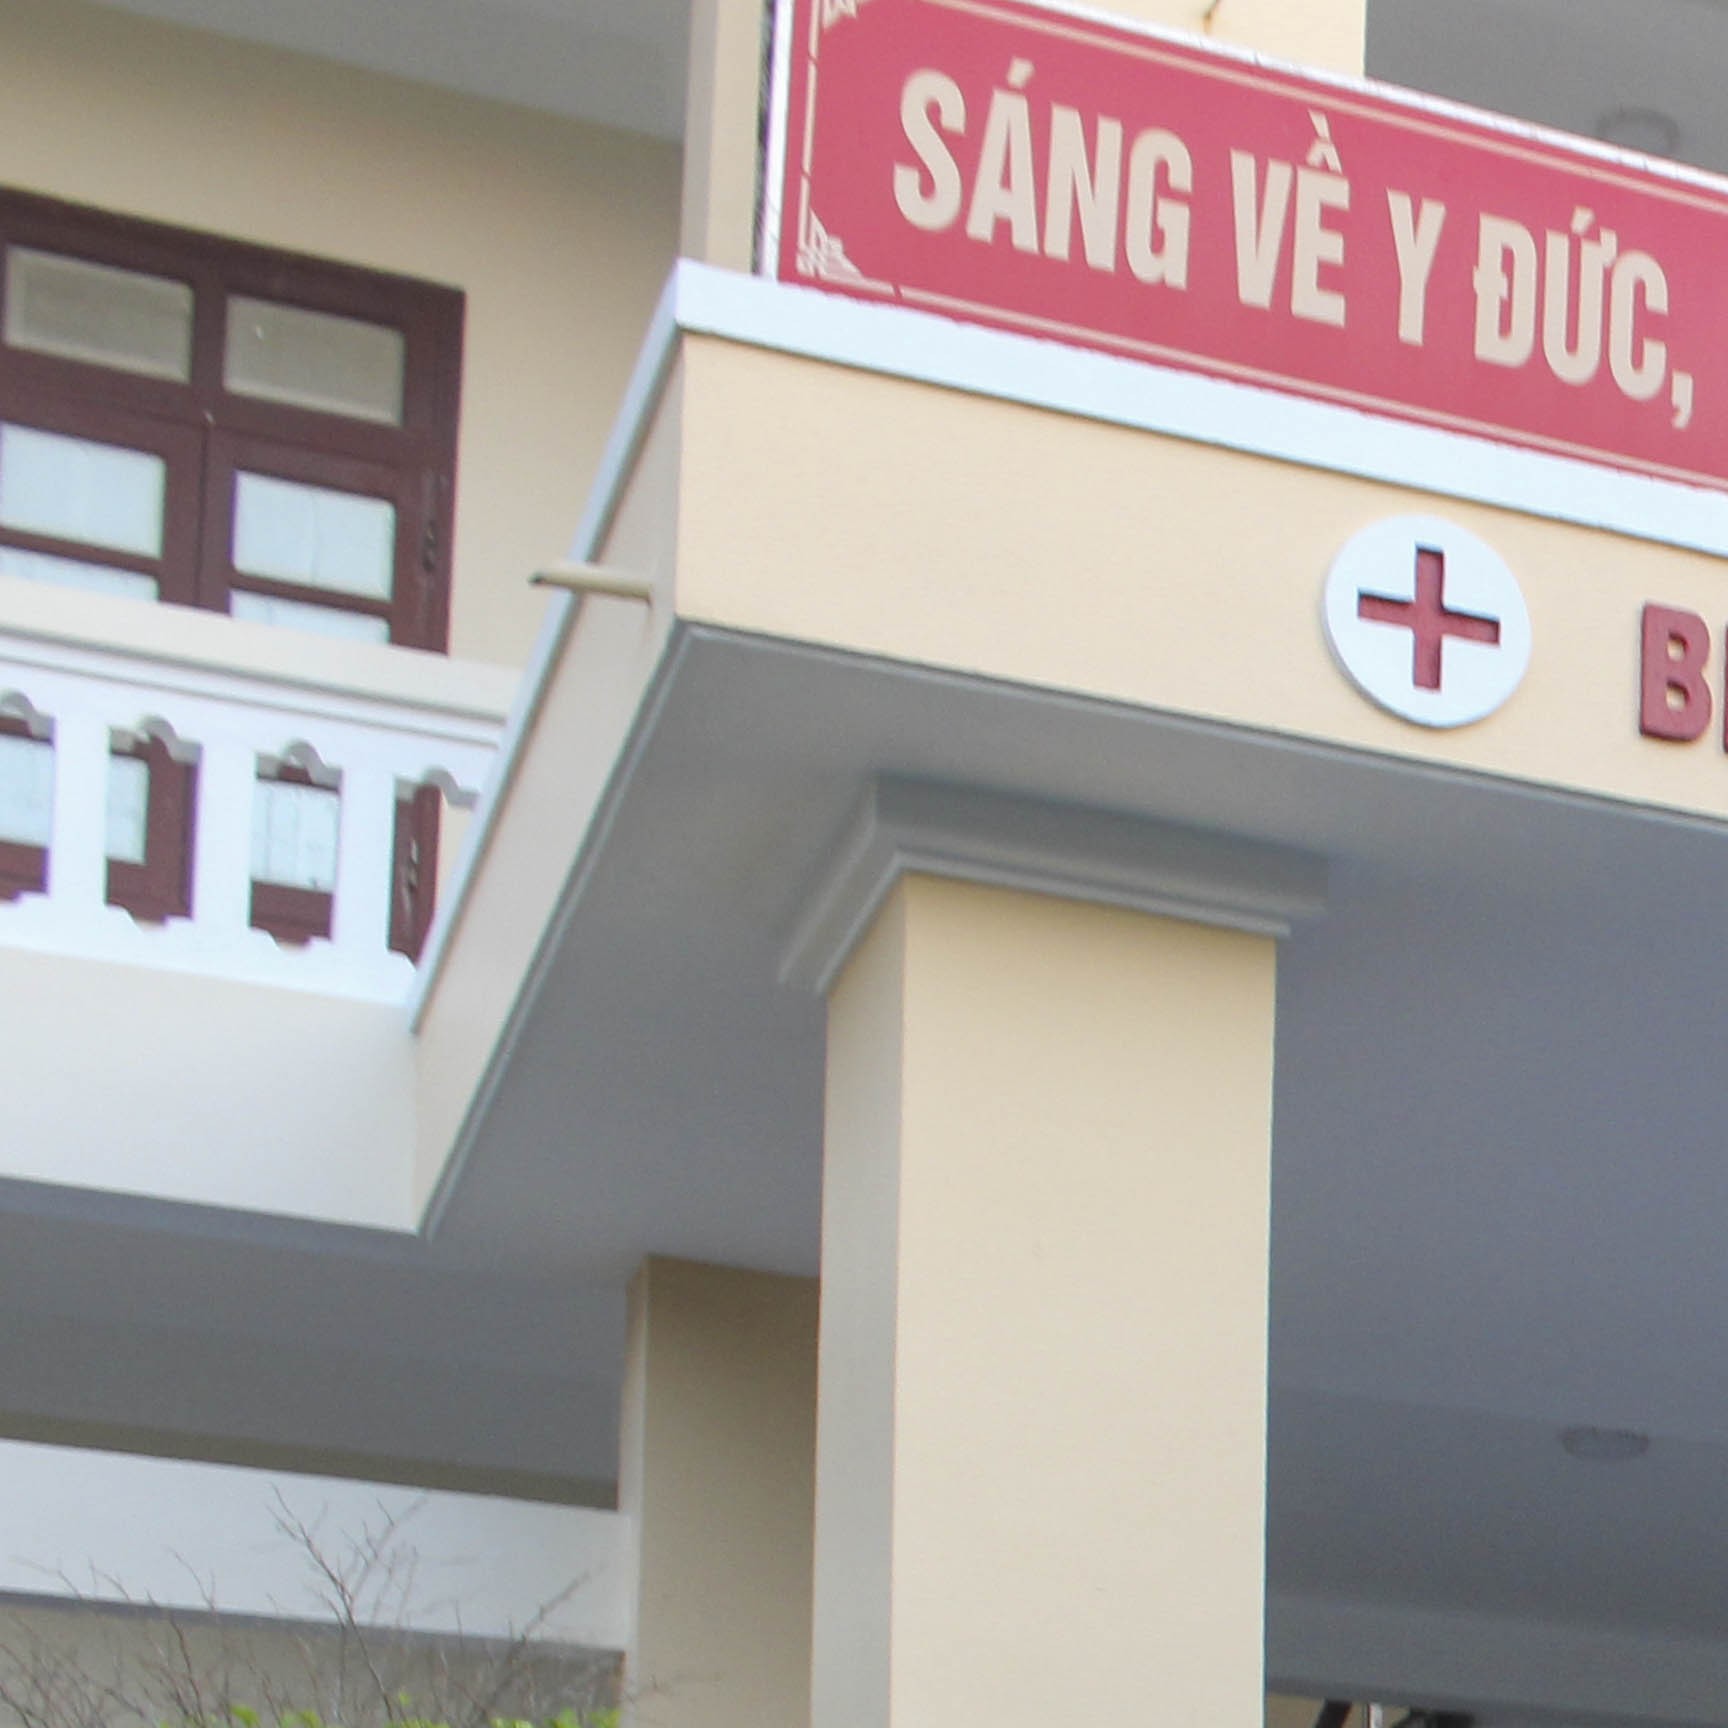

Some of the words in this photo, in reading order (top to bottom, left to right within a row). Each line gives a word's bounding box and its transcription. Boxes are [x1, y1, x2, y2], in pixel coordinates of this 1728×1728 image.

[894, 59, 1192, 290] SÁNG
[1231, 111, 1350, 328] VỀ
[1386, 189, 1446, 346] Y
[1472, 207, 1694, 429] ĐỨC,
